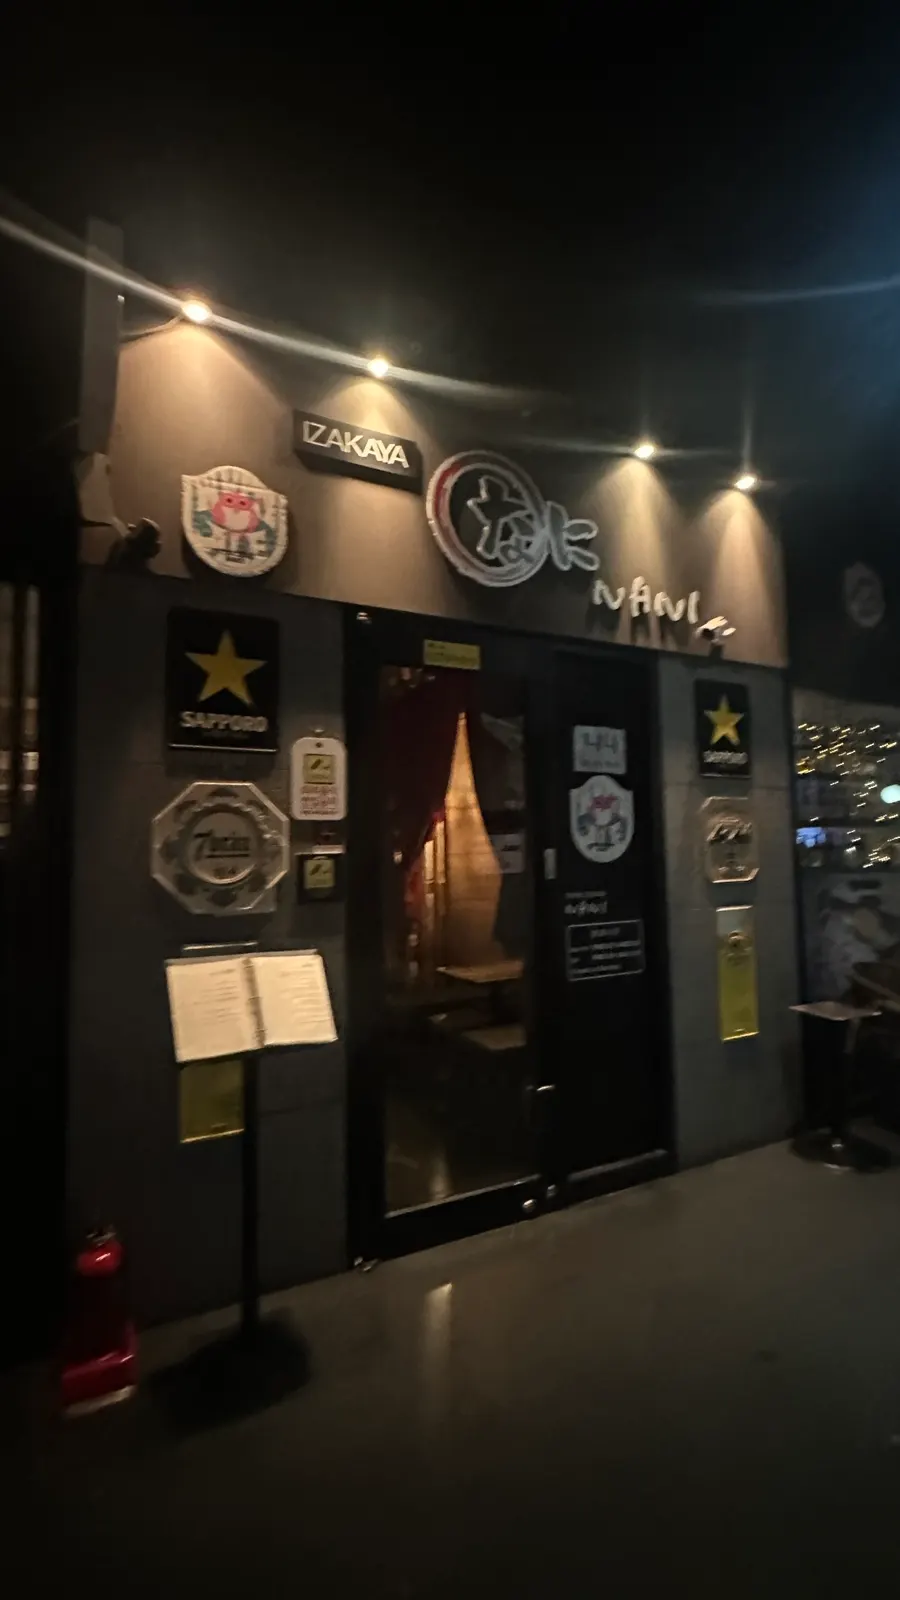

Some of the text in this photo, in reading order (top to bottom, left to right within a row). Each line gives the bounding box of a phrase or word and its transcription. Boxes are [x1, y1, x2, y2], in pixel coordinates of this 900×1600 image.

[302, 420, 409, 468] IZAKAYA
[592, 576, 700, 624] NANI
[179, 710, 269, 732] SAPPORO
